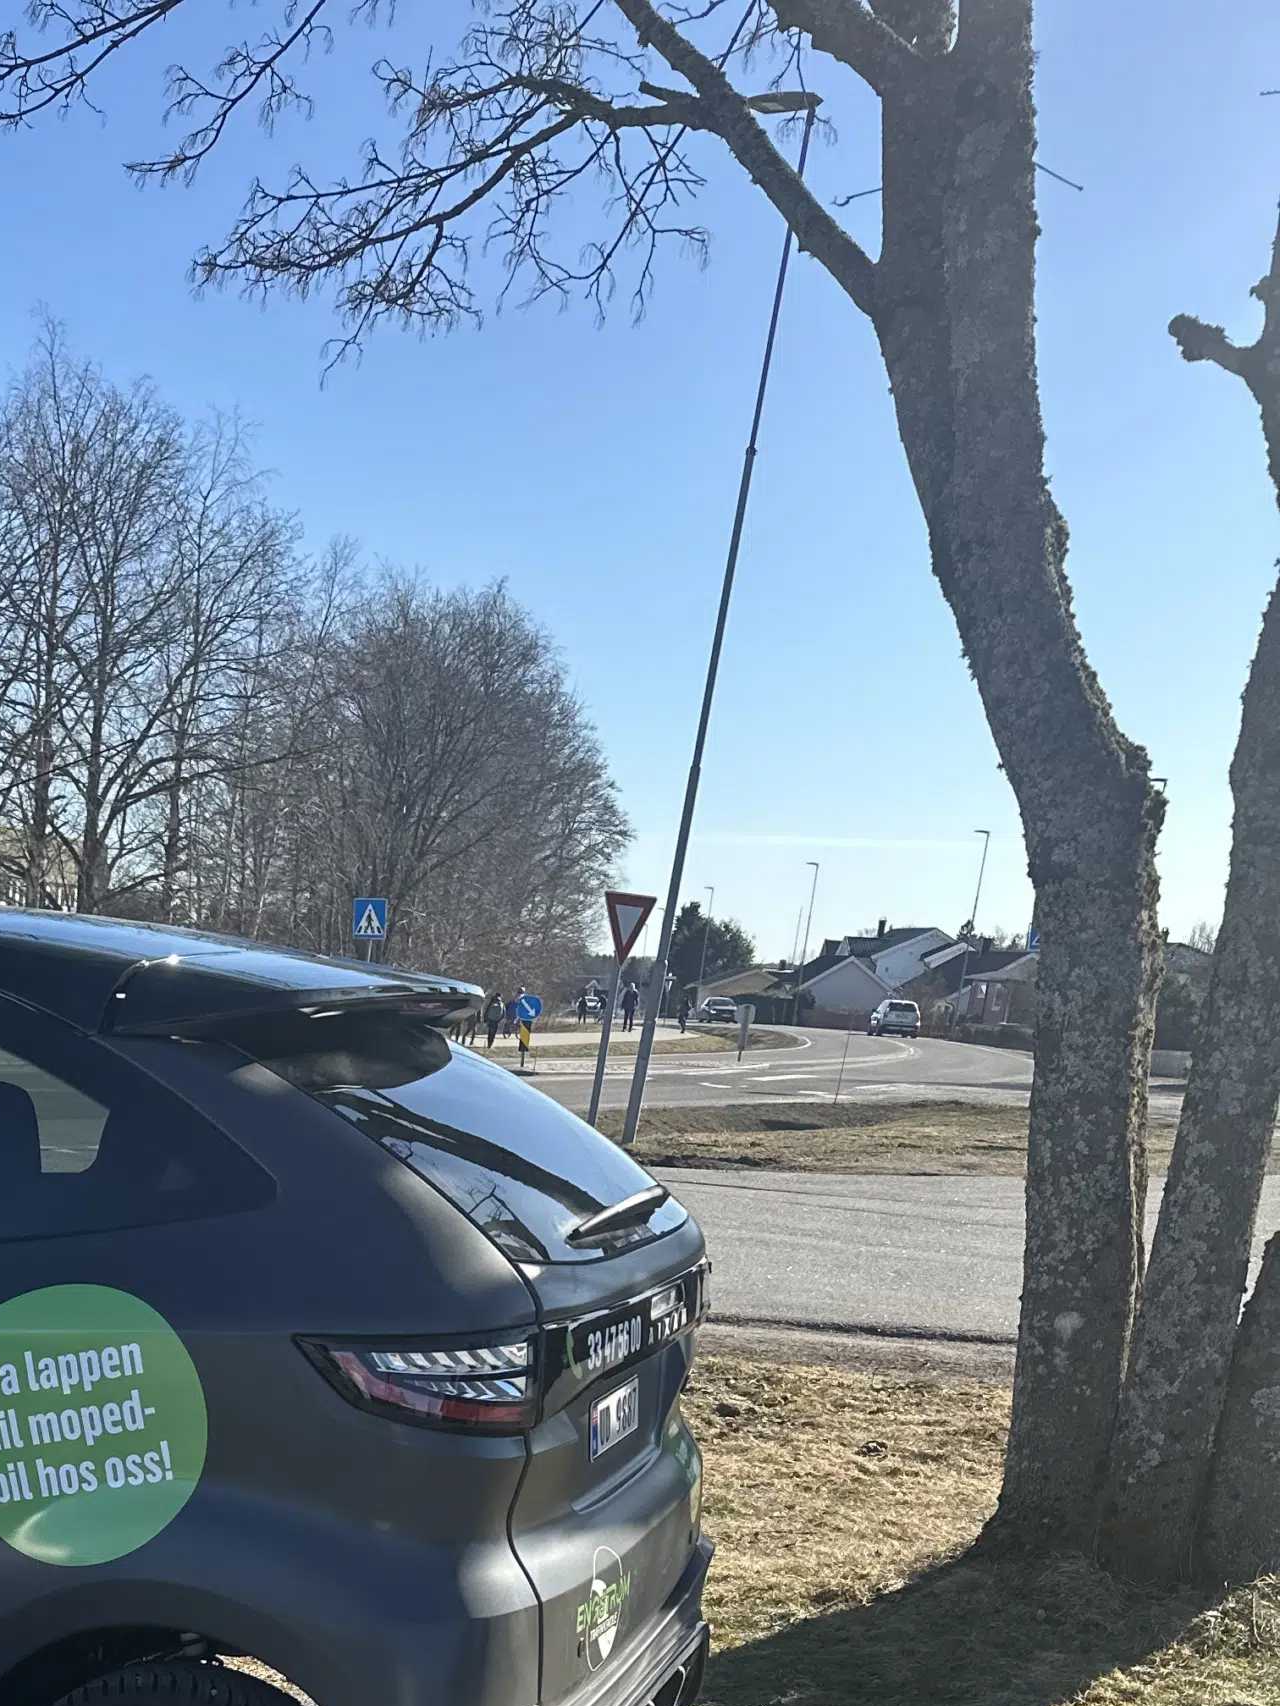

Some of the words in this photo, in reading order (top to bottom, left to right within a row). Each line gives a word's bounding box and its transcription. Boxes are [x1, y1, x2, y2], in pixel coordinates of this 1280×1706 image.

[23, 1341, 144, 1395] lappen
[587, 1331, 603, 1370] 33
[604, 1327, 617, 1364] 47
[617, 1322, 630, 1359] 56
[630, 1315, 642, 1354] 00
[27, 1389, 156, 1446] moped-
[35, 1458, 98, 1498] hos
[104, 1439, 174, 1489] oss!
